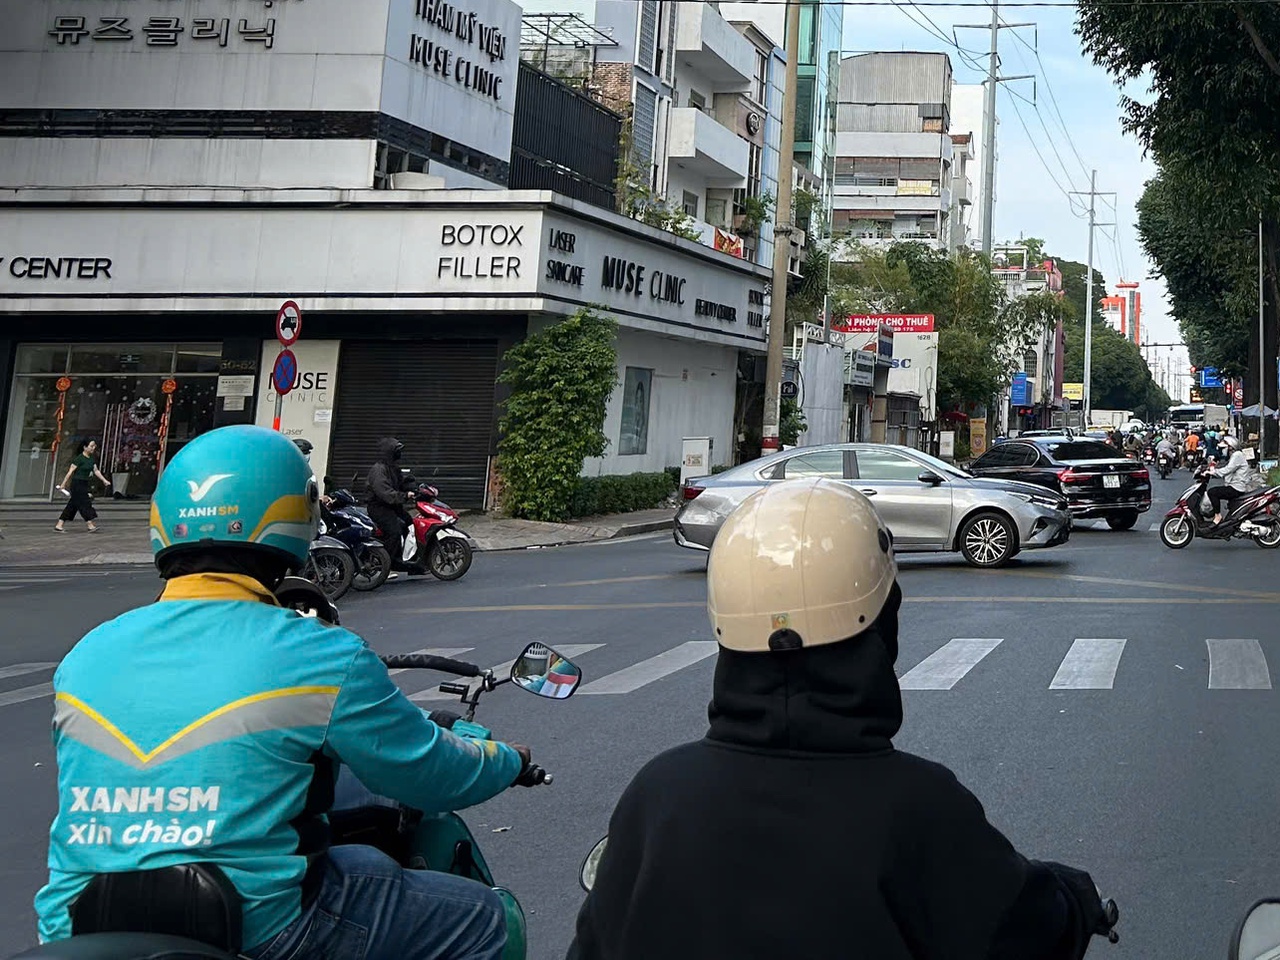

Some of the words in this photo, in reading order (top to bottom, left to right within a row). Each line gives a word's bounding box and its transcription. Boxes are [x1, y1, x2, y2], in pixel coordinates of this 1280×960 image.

[48, 15, 276, 49] 뮤즈클리닉
[409, 33, 453, 77] MUSE
[455, 56, 503, 101] CLINIC
[441, 224, 524, 246] BOTOX
[549, 228, 576, 254] LASER
[9, 256, 113, 279] CENTER
[437, 256, 521, 279] FILLER
[546, 259, 585, 286] SKINCARE
[601, 255, 645, 296] MUSE
[650, 270, 687, 305] CLINIC
[885, 317, 904, 327] CHO
[906, 316, 929, 327] THUÊ
[268, 372, 328, 390] USE
[266, 392, 327, 403] CINIC
[282, 427, 304, 436] Laser
[67, 817, 112, 846] xin
[121, 818, 216, 847] chào!
